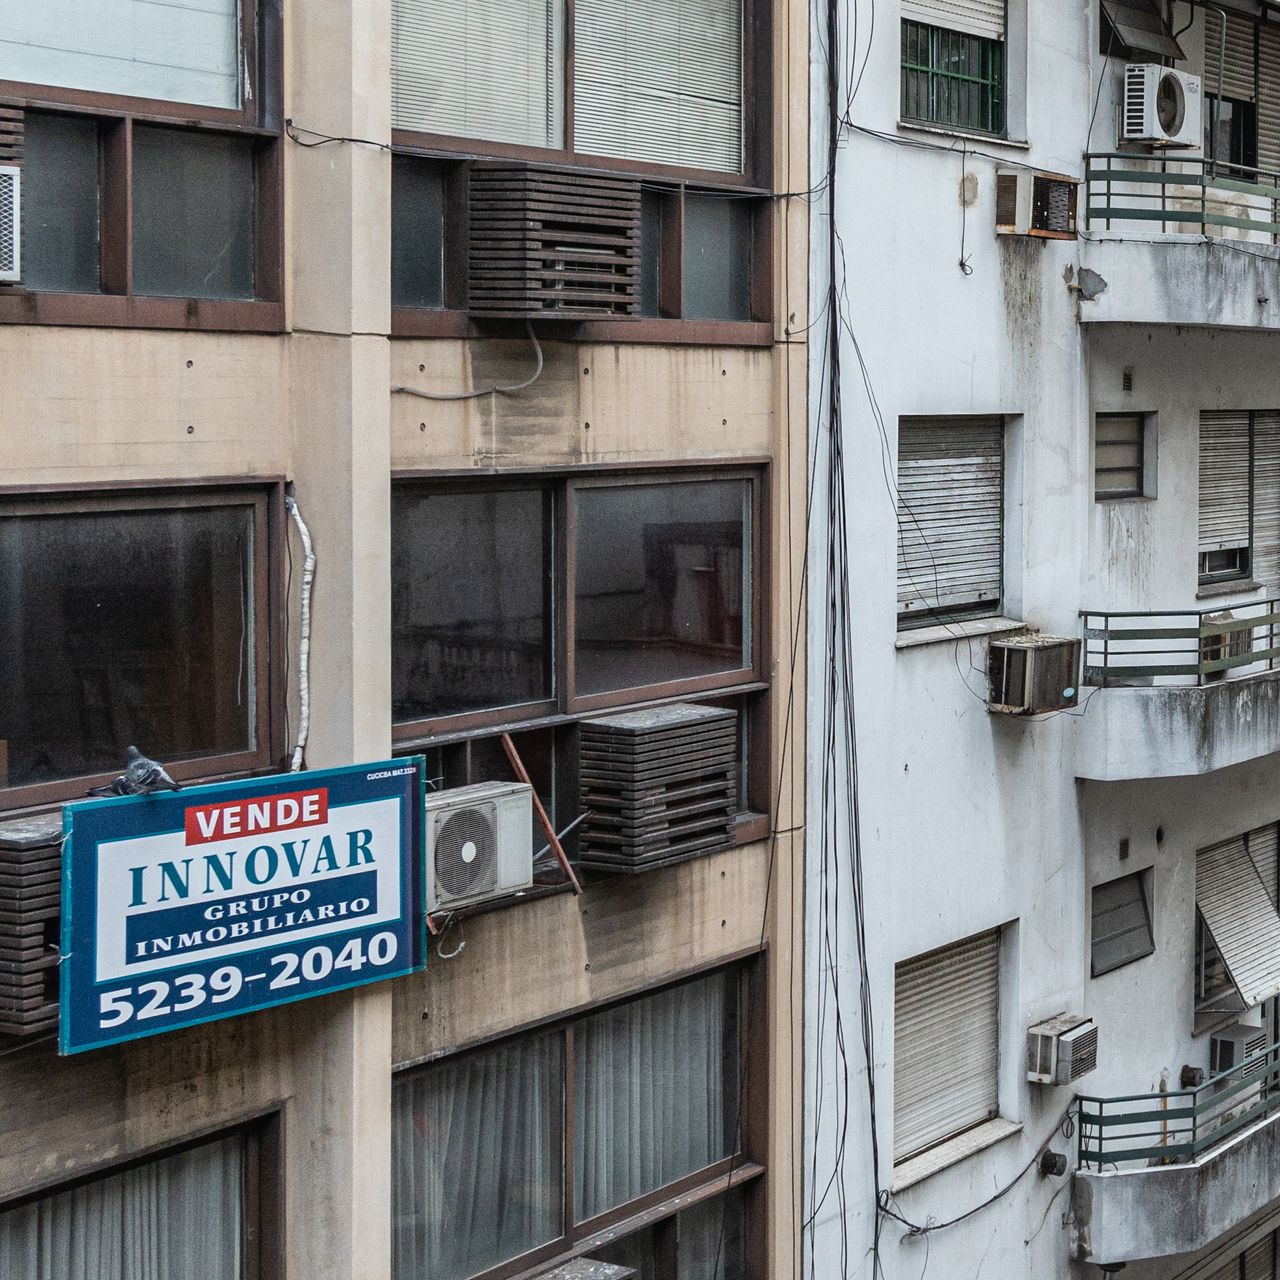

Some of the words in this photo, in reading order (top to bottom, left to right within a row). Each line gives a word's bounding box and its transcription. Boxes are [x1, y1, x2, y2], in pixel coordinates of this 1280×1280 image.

[196, 794, 320, 838] VENDE
[128, 828, 375, 907] INNOVAR
[136, 897, 370, 956] INMOBILIARIO
[204, 888, 311, 920] GRUPO
[99, 931, 397, 1028] 5239-2040
